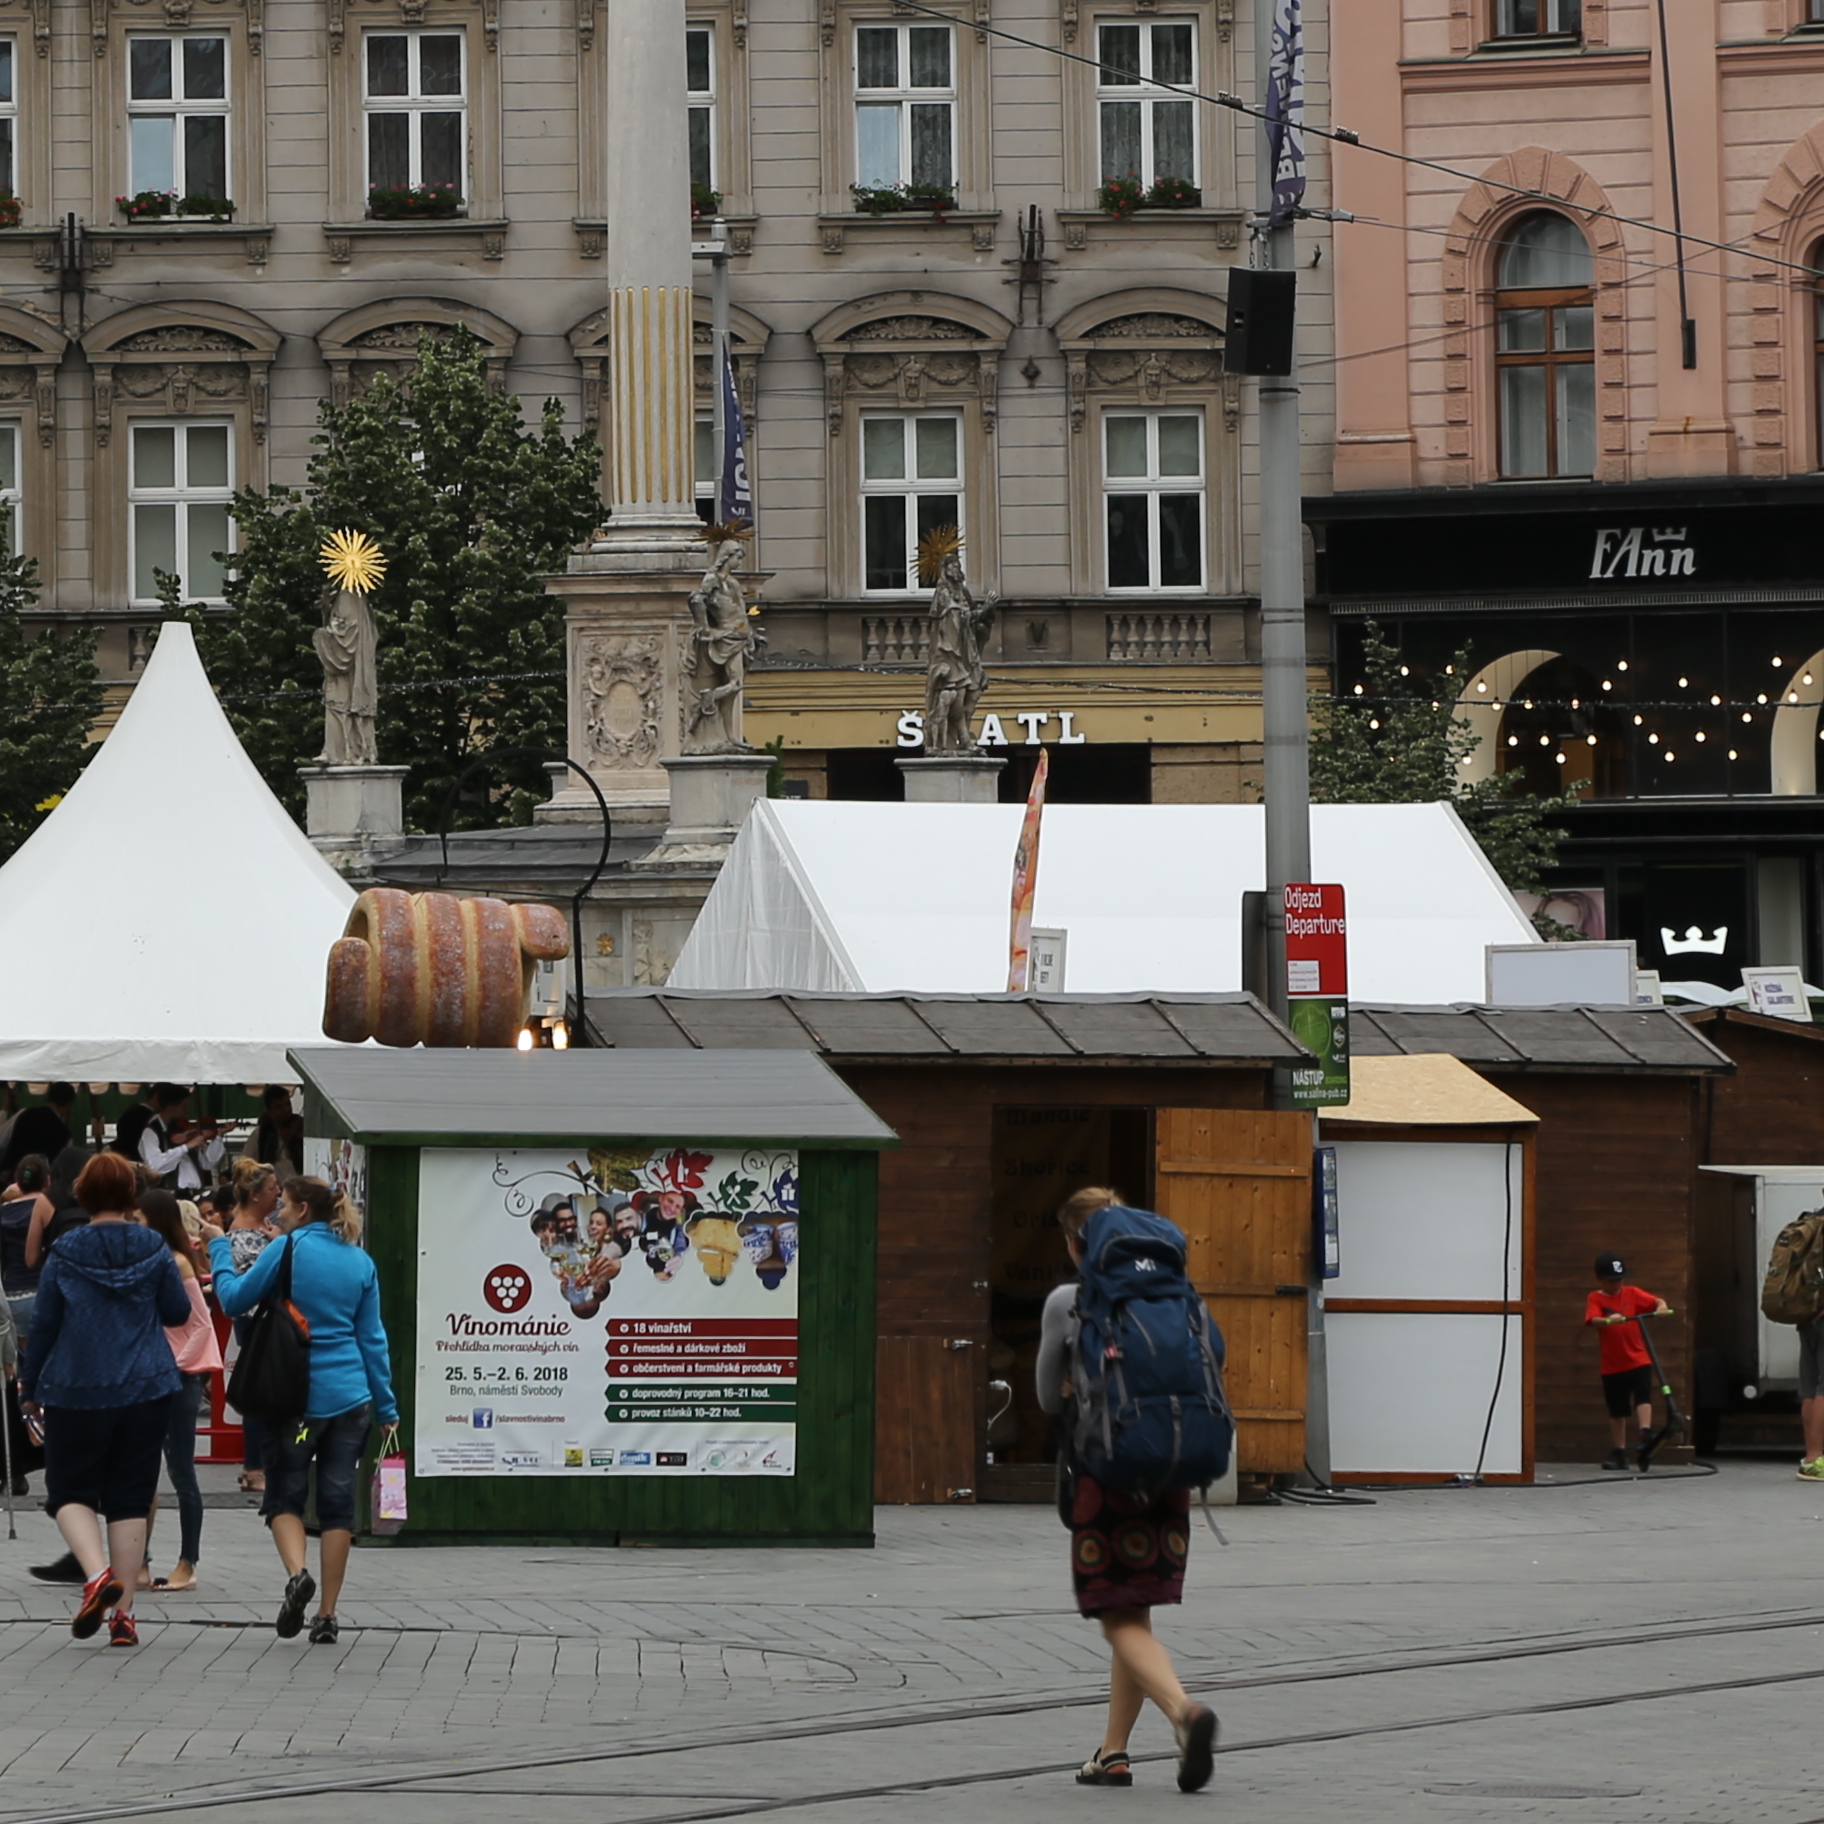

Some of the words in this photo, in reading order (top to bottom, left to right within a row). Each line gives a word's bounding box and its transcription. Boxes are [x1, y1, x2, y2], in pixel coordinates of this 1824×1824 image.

[1589, 527, 1696, 578] FAnn
[897, 710, 1086, 747] ŠATL
[1284, 887, 1322, 913] Odjezd
[1286, 914, 1345, 939] Departure
[1292, 1068, 1325, 1086] NÁSTUP
[633, 1323, 646, 1333] 18
[648, 1322, 692, 1334] vinařství
[435, 1340, 490, 1352] Přehlídka
[493, 1340, 561, 1355] moravských
[563, 1342, 579, 1352] vín
[633, 1342, 675, 1353] řemeslné
[676, 1345, 682, 1353] a
[684, 1342, 720, 1353] dárkové
[722, 1342, 746, 1353] zboží
[445, 1366, 467, 1381] 25.
[515, 1366, 528, 1381] 6.
[533, 1366, 568, 1381] 2018
[632, 1362, 685, 1373] občerstvení
[686, 1365, 692, 1373] a
[694, 1362, 740, 1373] farmářské
[742, 1363, 782, 1374] produkty
[450, 1384, 476, 1397] Brno,
[478, 1384, 518, 1396] náměstí
[521, 1384, 563, 1398] Svobody
[632, 1388, 682, 1399] doprovodný
[684, 1389, 721, 1399] program
[751, 1388, 770, 1398] hod.
[445, 1415, 469, 1425] sleduj
[631, 1409, 660, 1419] provoz
[662, 1407, 692, 1417] stánků
[722, 1407, 742, 1417] hod.
